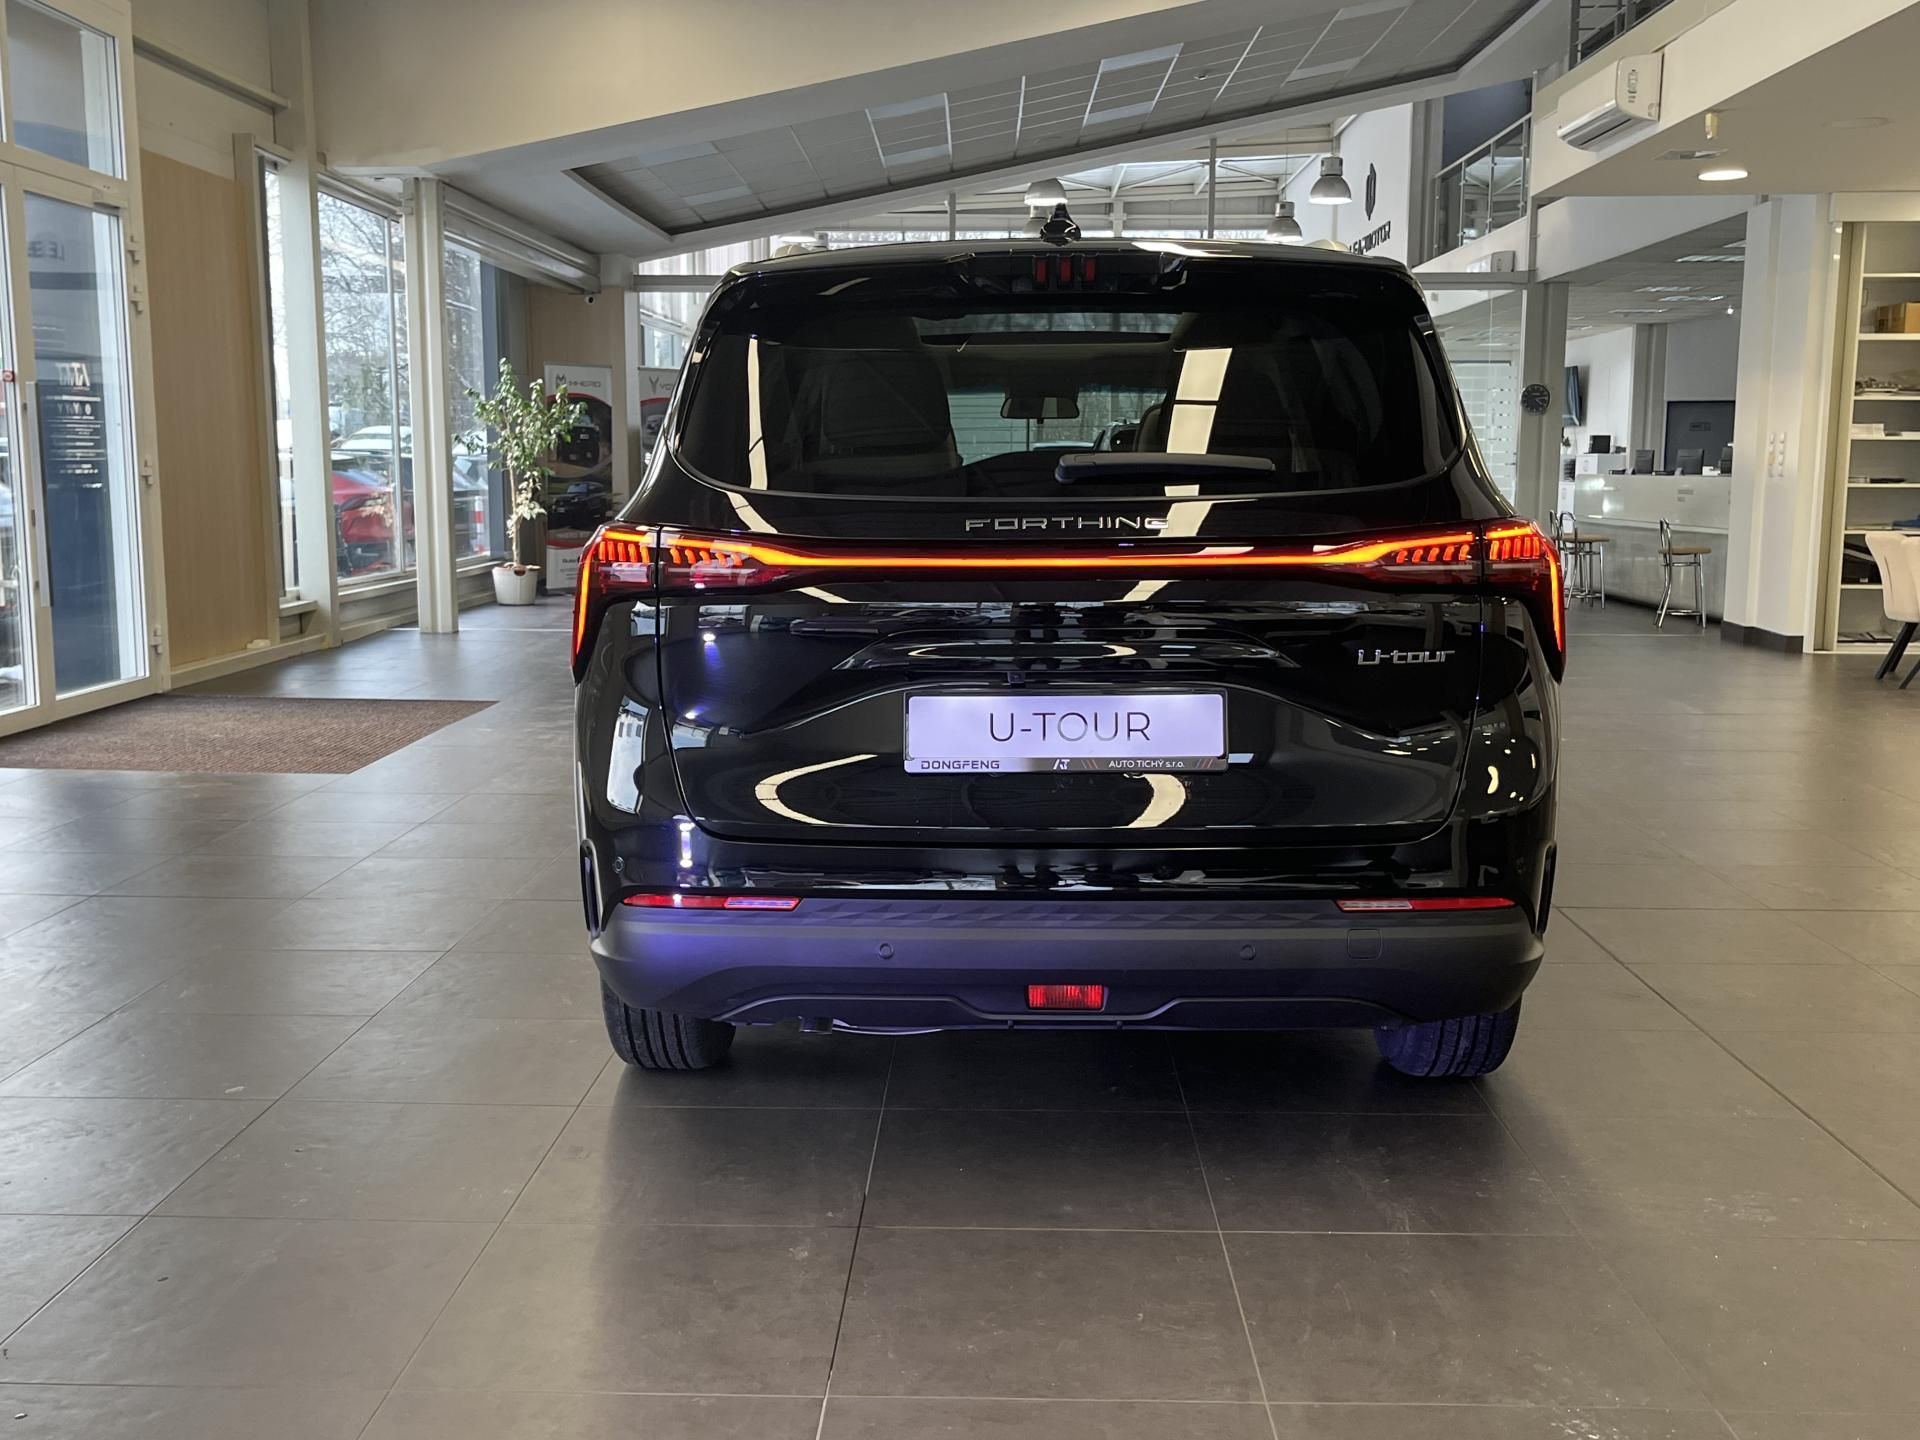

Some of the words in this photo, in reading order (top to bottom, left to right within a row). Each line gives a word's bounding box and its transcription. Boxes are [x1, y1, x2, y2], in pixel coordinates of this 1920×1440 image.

[965, 516, 1169, 532] FORTHING
[1357, 649, 1456, 665] U-tour
[989, 711, 1150, 742] U-TOUR
[920, 759, 1001, 770] DONGFENG
[1108, 759, 1135, 768] AUTO
[1165, 760, 1185, 768] s.r.o.
